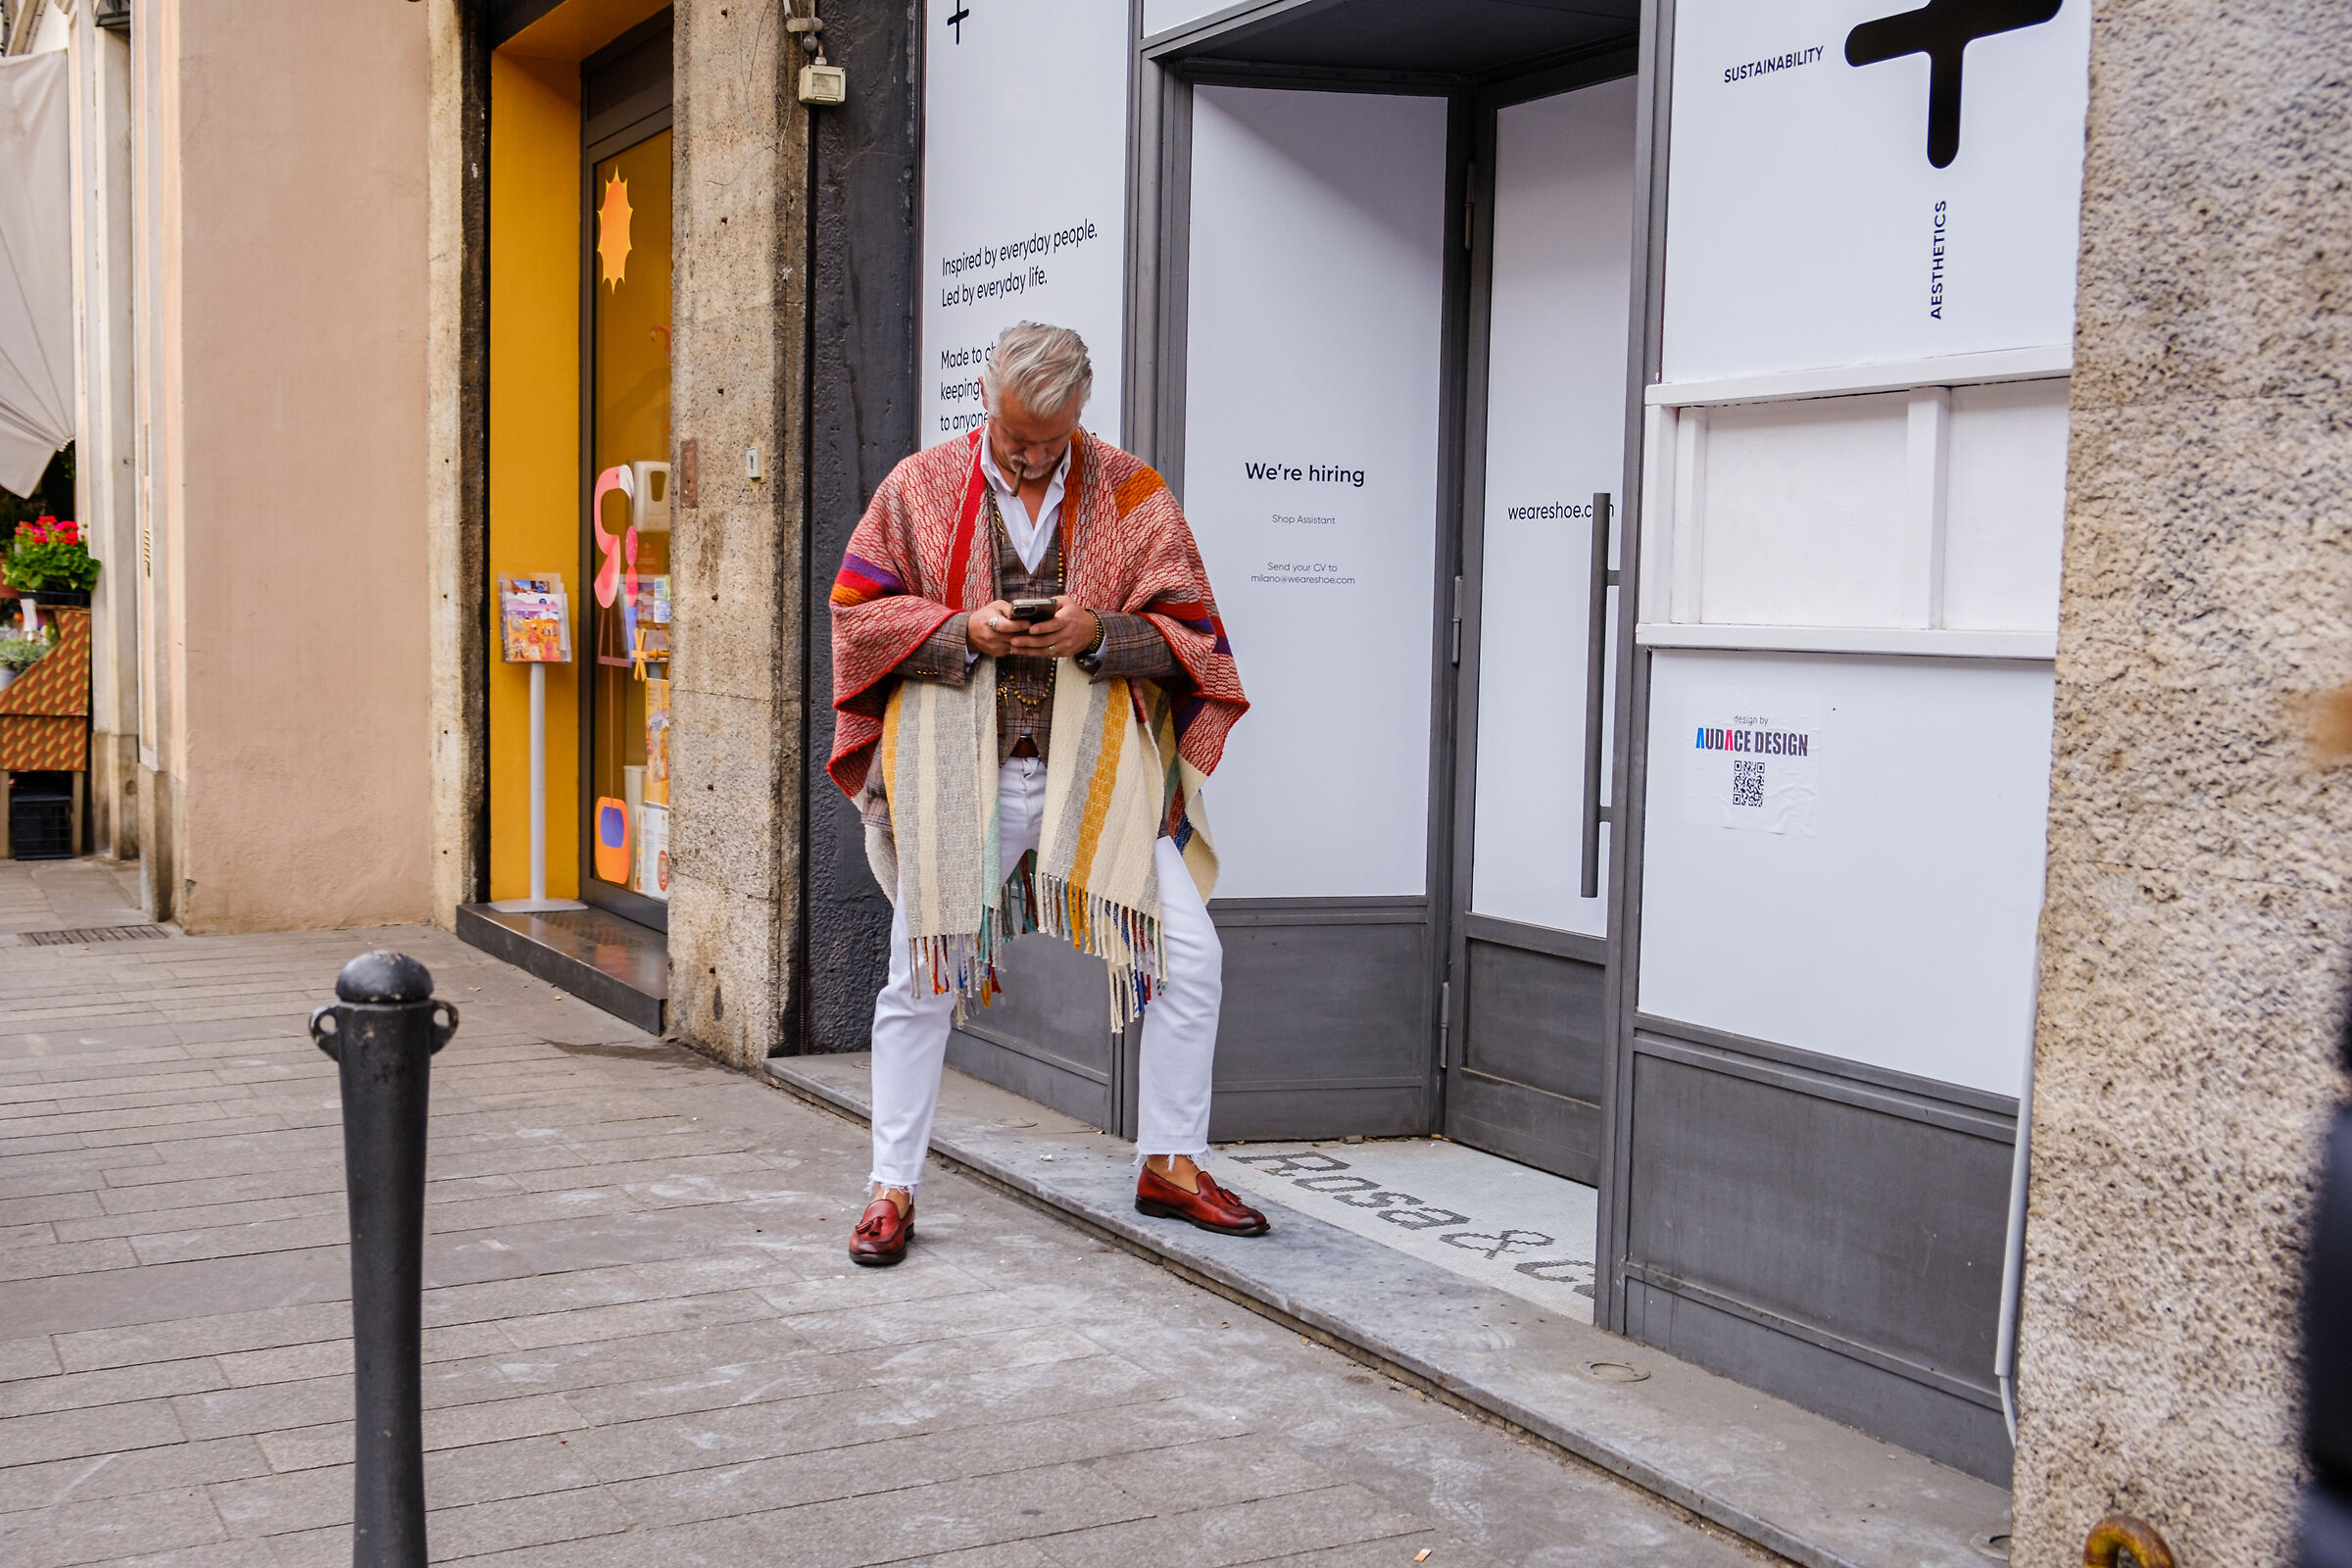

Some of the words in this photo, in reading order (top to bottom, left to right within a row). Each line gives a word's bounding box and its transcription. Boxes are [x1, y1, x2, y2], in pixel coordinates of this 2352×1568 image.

[1724, 46, 1824, 83] SUSTAINABILITY
[942, 248, 982, 278] Inspired
[984, 246, 998, 268] by
[1000, 233, 1051, 261] everyday
[1054, 219, 1098, 253] people.
[1930, 200, 1947, 320] AESTHETICS
[942, 285, 959, 307] Led
[962, 283, 975, 306] by
[977, 272, 1026, 298] everyday
[1028, 266, 1048, 288] life.
[941, 347, 969, 369] Made
[971, 347, 982, 364] to
[940, 378, 980, 403] keeping
[940, 415, 951, 431] to
[1245, 462, 1302, 481] We're
[1308, 465, 1365, 488] hiring
[1272, 514, 1295, 525] Shop
[1297, 515, 1336, 524] Assistant
[1250, 574, 1355, 585] milano@weareshoe.com
[1267, 562, 1291, 572] Send
[1292, 564, 1311, 573] your
[1312, 564, 1327, 572] CV
[1734, 715, 1757, 726] design
[1759, 716, 1769, 727] by
[1754, 731, 1808, 757] DESIGN
